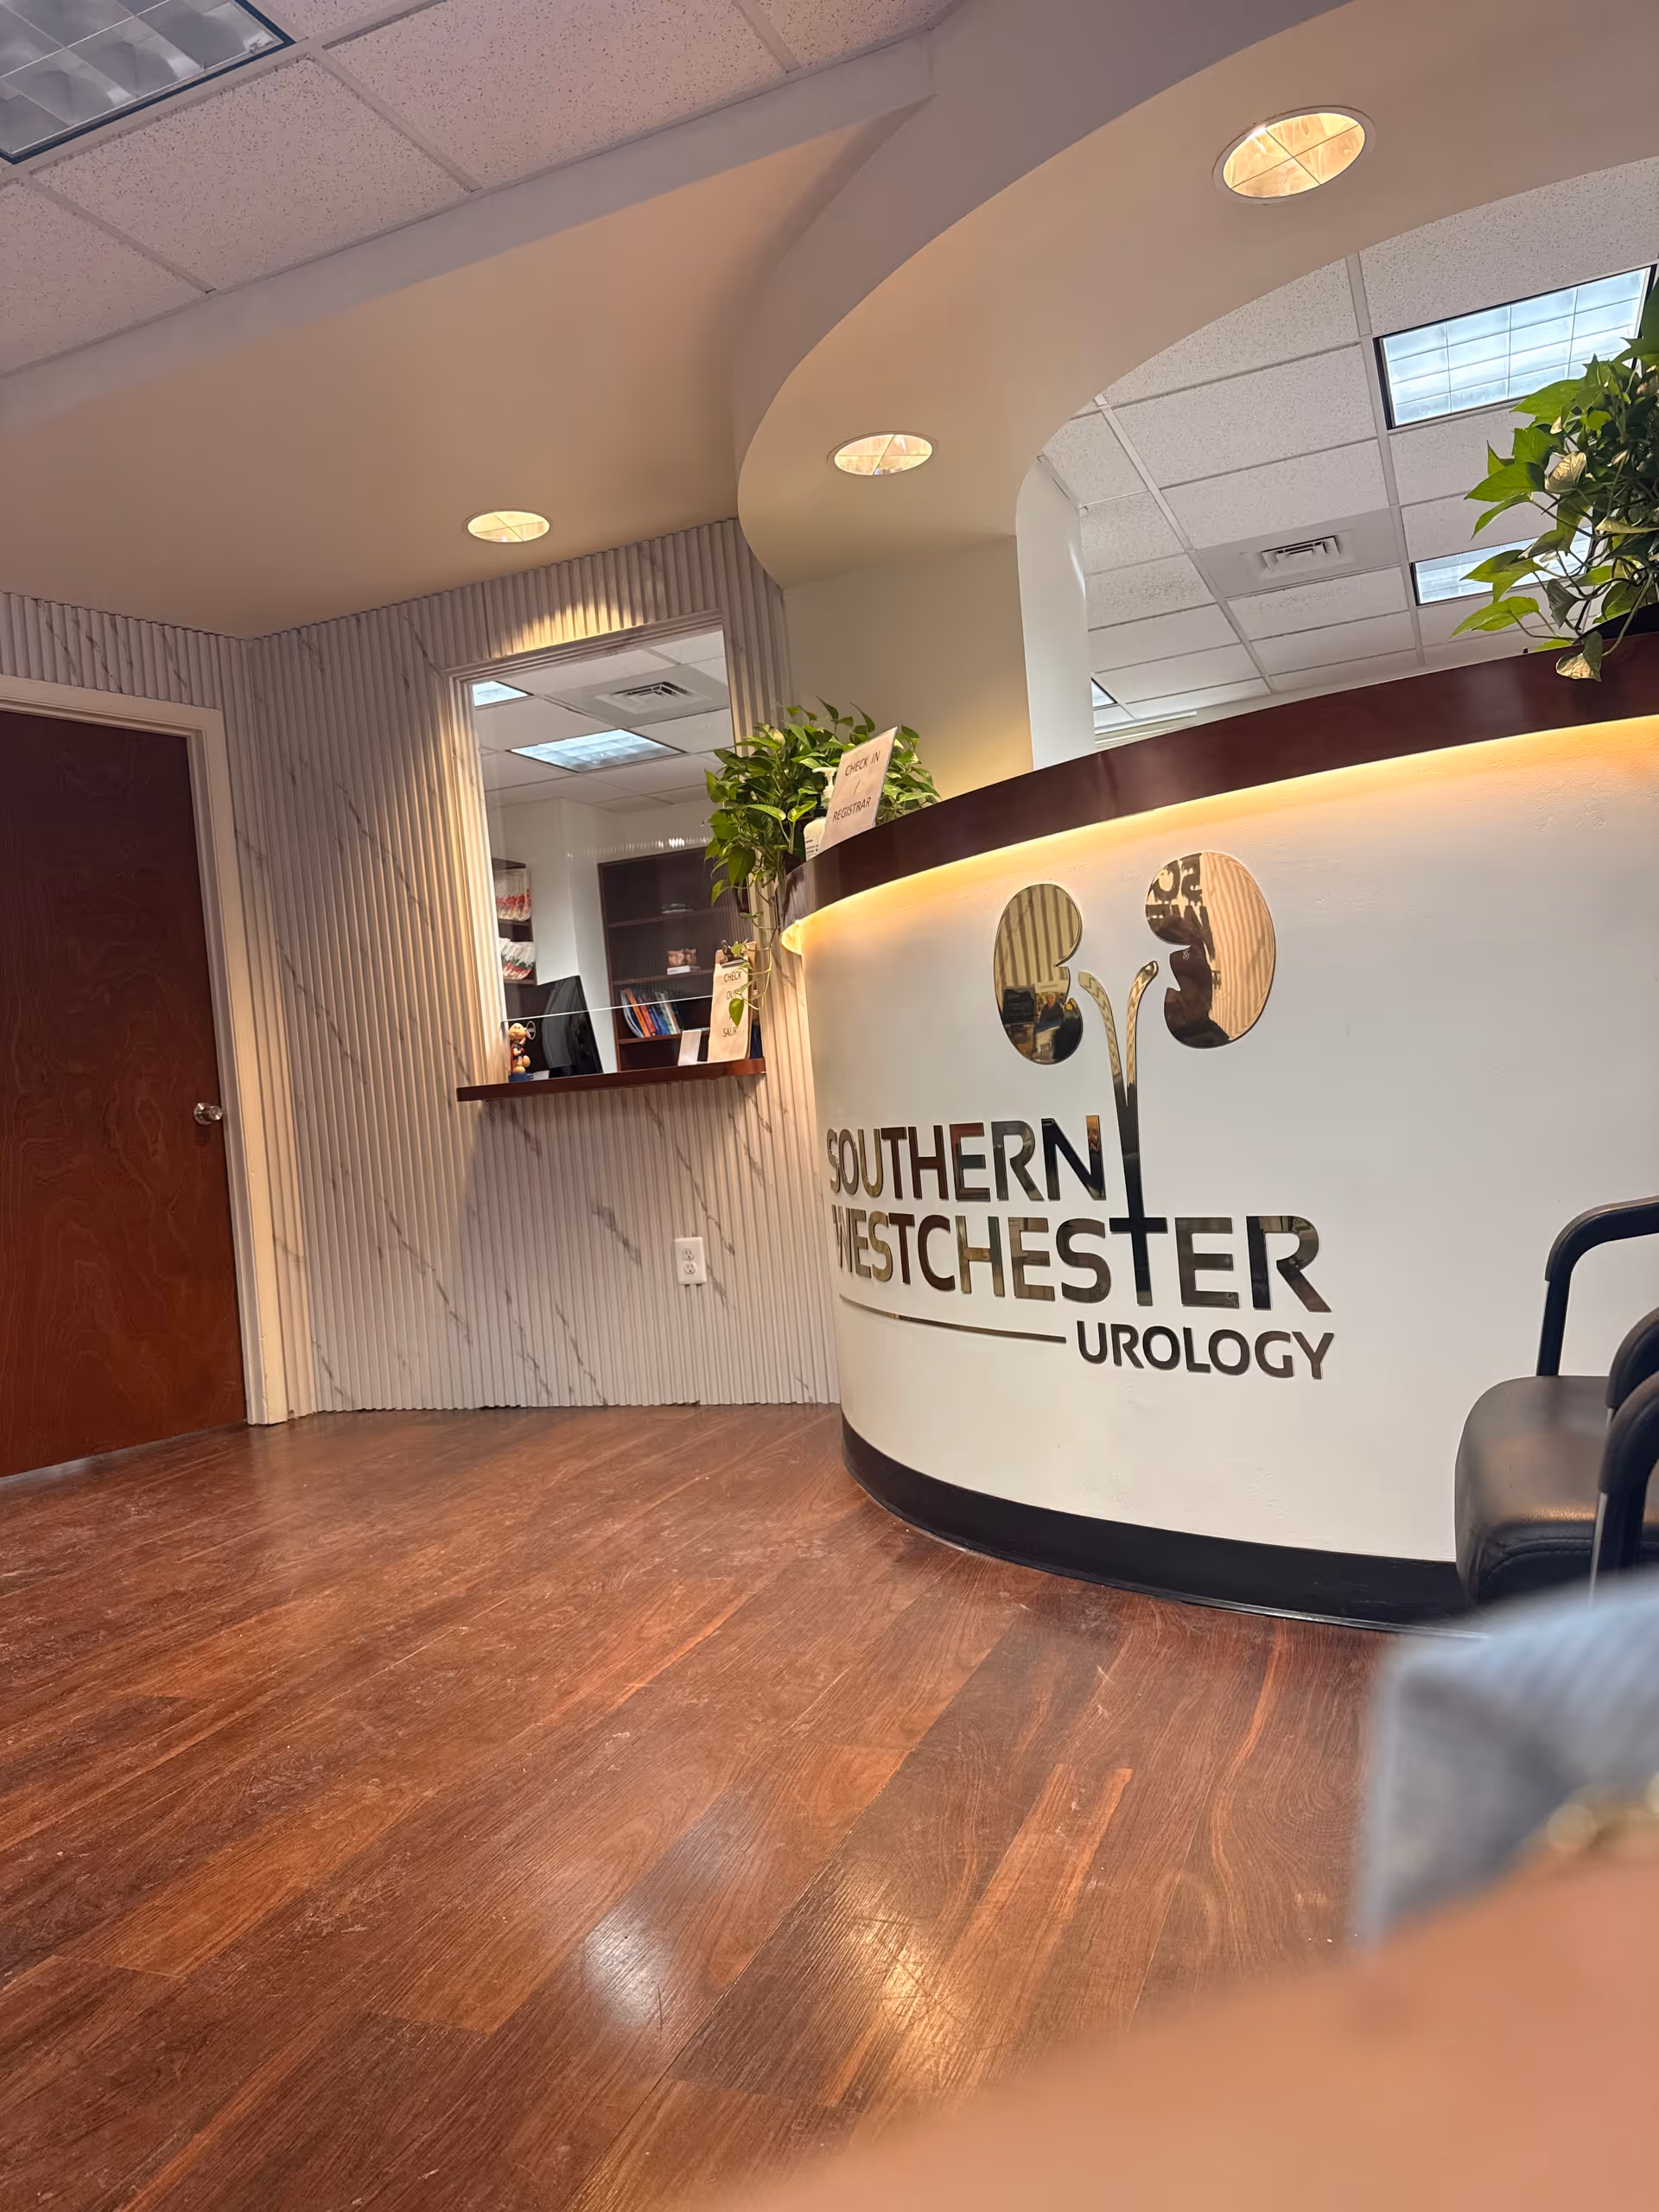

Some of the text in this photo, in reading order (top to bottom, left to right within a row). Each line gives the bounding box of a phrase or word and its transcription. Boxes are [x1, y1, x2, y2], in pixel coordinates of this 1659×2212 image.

[845, 752, 880, 776] CHECK IN
[833, 798, 871, 821] REGISTRAR
[724, 971, 741, 982] CHECK
[827, 1116, 1106, 1202] SOUTHERN
[831, 1205, 1332, 1313] WESTCHESTER
[1077, 1320, 1335, 1380] UROLOGY
